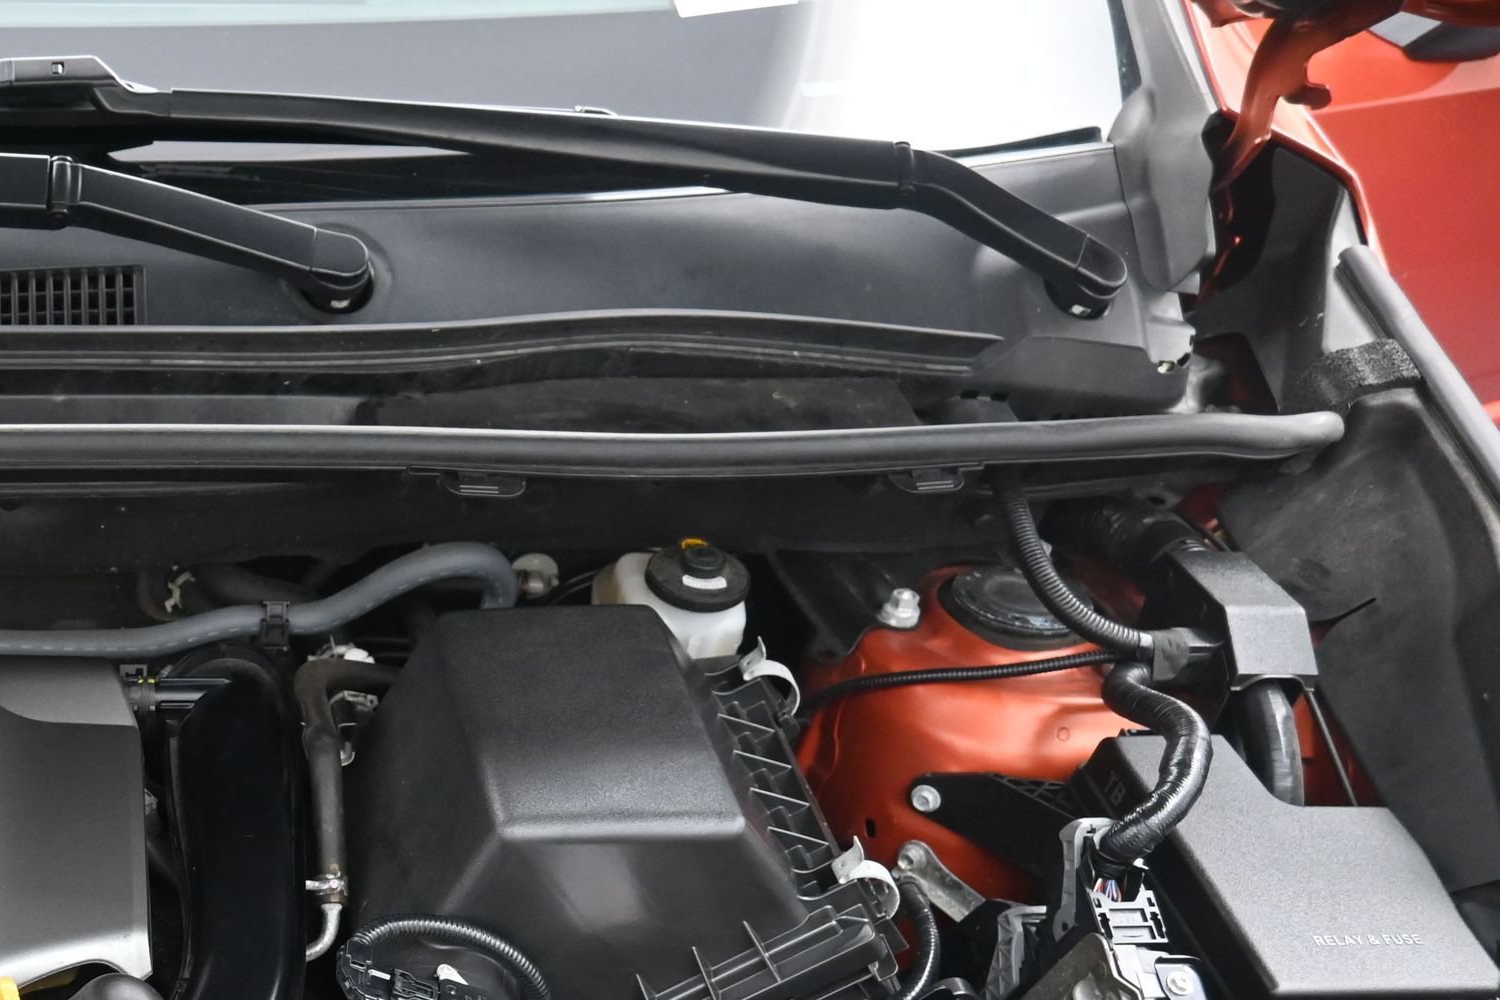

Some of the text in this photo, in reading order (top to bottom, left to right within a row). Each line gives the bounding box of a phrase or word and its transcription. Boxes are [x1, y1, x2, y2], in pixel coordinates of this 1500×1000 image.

[1312, 933, 1423, 946] RELAY & FUSE
